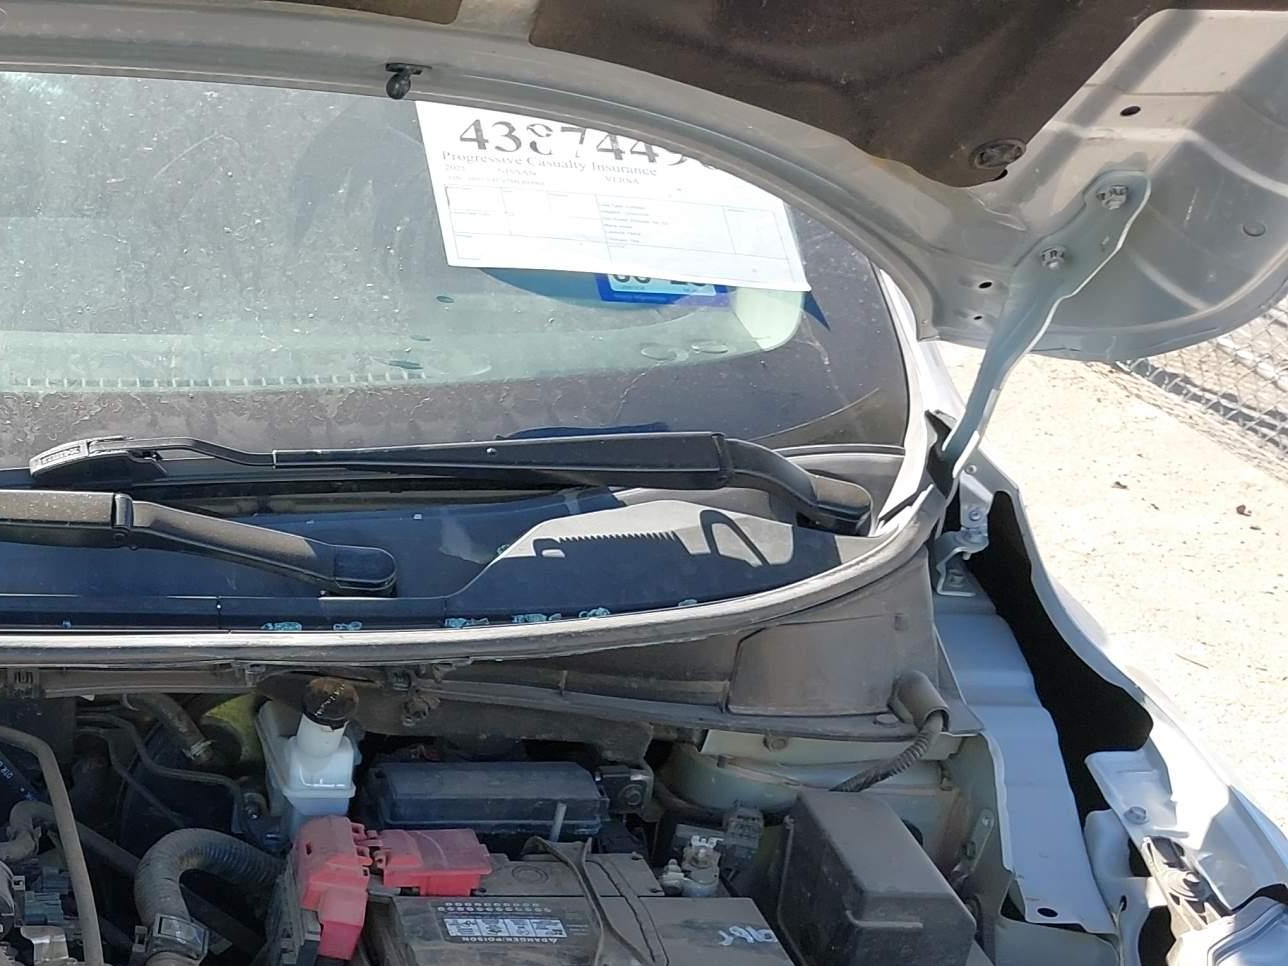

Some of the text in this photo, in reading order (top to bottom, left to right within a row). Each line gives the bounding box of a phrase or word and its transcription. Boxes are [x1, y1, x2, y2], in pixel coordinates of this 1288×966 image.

[442, 151, 657, 176] Progressive Casualty Insurance
